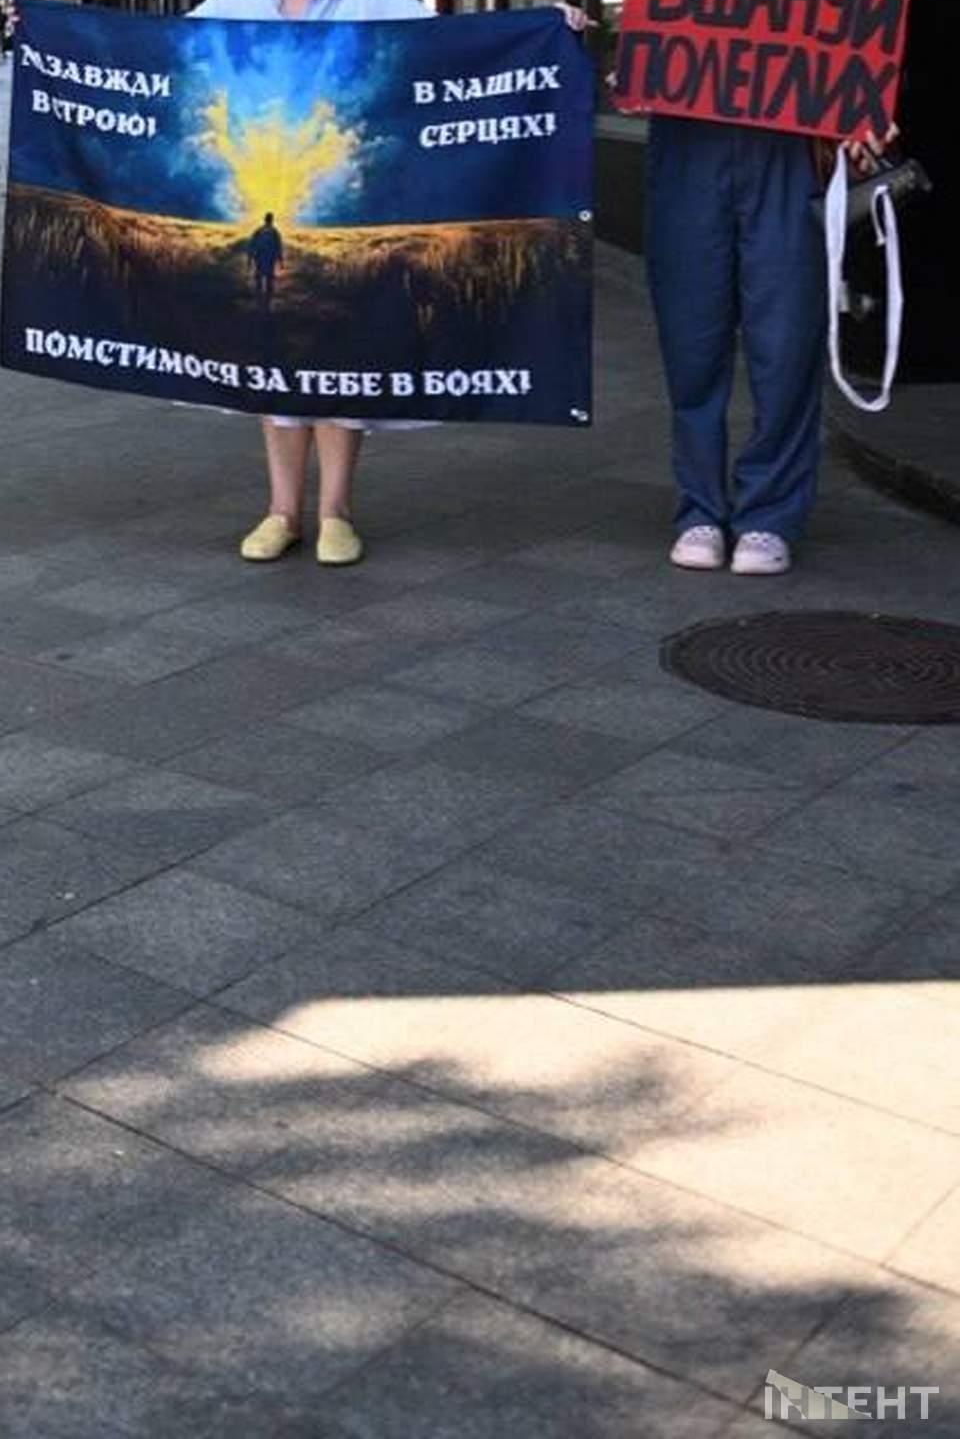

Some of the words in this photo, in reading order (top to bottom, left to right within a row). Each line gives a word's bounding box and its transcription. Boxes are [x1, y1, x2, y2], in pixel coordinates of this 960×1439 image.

[20, 44, 172, 97] НЗАВЖДИ
[413, 81, 436, 104] В
[442, 65, 561, 102] НАШИХ
[618, 29, 898, 137] ПОЛЕГЛИХ
[420, 113, 557, 148] СЕРЦЯХ!
[26, 327, 239, 387] ПОМСТИМОСЯ
[246, 366, 289, 392] ЗА
[295, 370, 381, 396] ТЕБЕ
[390, 372, 414, 395] В
[423, 369, 531, 396] БОЯХ!
